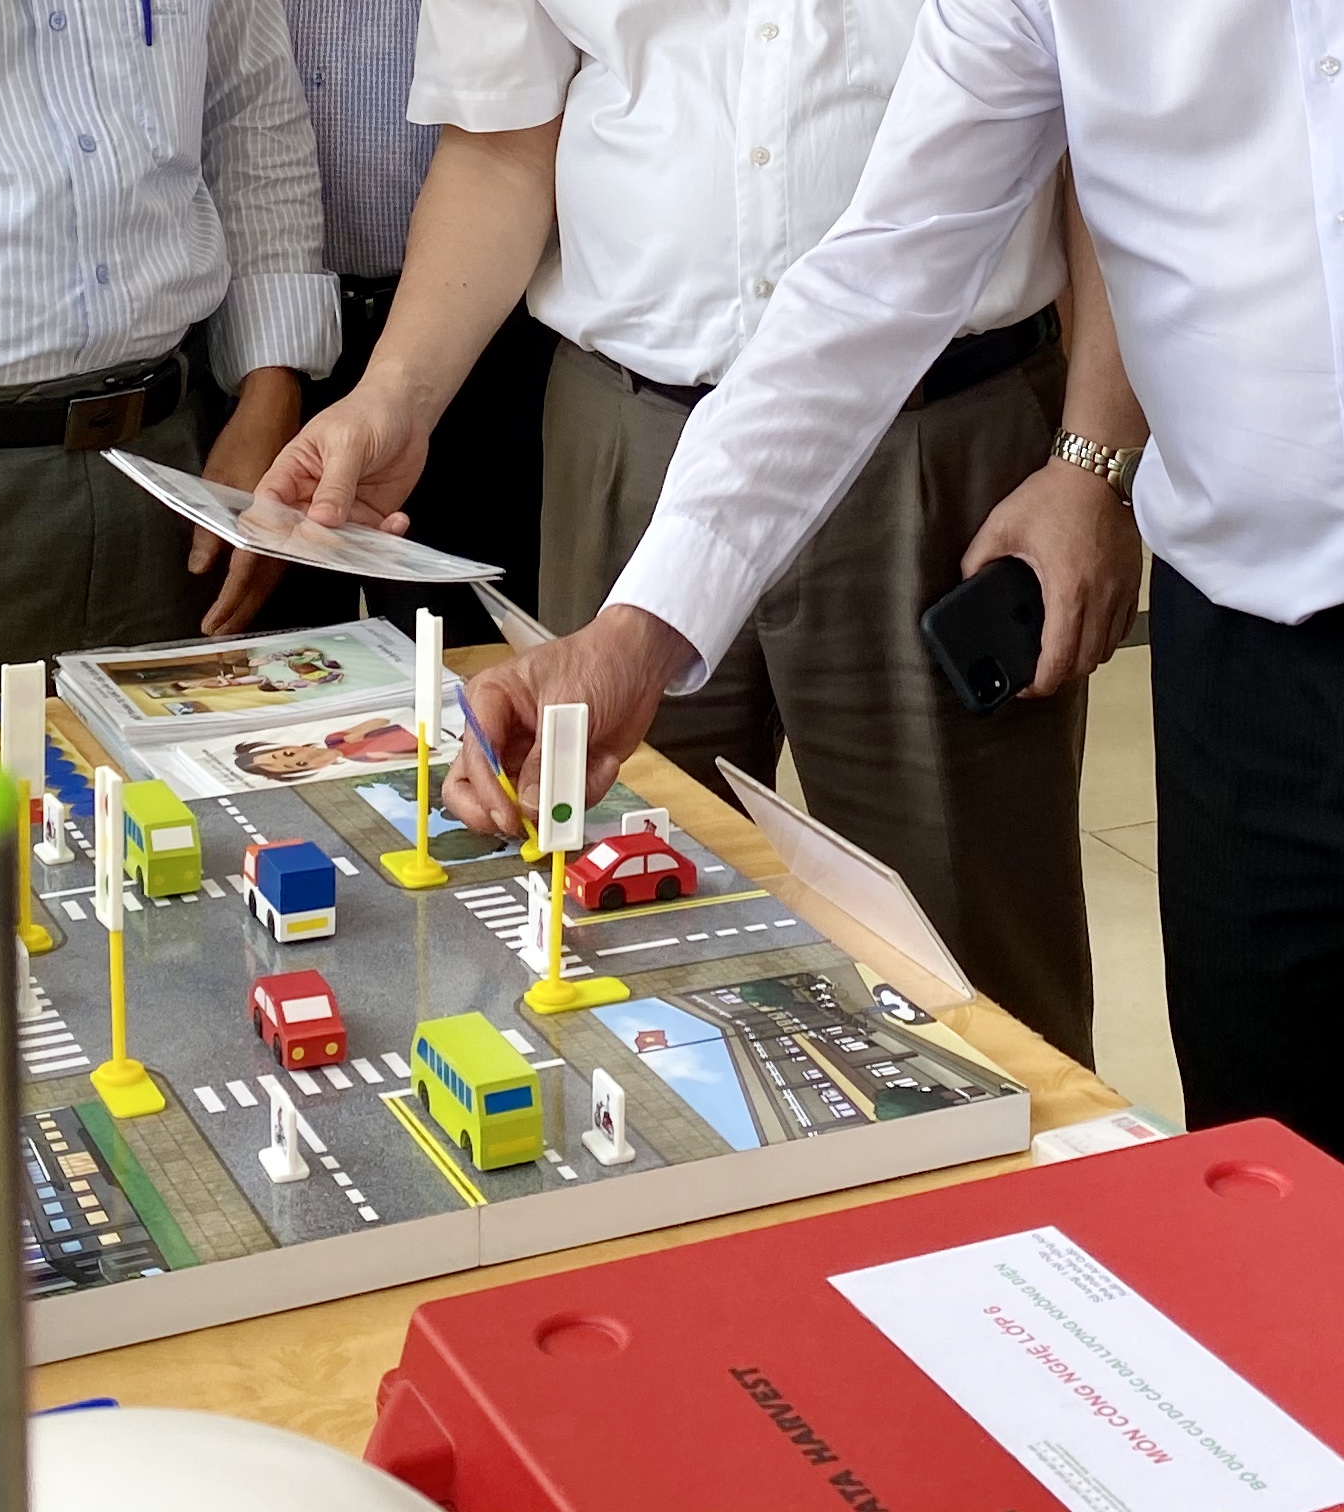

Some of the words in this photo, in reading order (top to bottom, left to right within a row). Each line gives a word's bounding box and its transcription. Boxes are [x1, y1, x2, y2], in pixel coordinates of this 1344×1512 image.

[993, 1262, 1027, 1288] ĐIỆN
[982, 1305, 1002, 1316] 6
[1021, 1285, 1069, 1321] KHÔNG
[993, 1315, 1036, 1345] LỚP
[1062, 1319, 1112, 1361] LƯỢNG
[1026, 1343, 1082, 1385] NGHỆ
[1105, 1356, 1136, 1379] ĐẠI
[1073, 1384, 1130, 1428] CÔNG
[1128, 1376, 1162, 1403] CÁC
[727, 1367, 841, 1466] HARVEST
[1177, 1417, 1204, 1439] CỤ
[1122, 1428, 1174, 1466] MÔN
[1199, 1435, 1245, 1473] DỤNG
[1239, 1469, 1269, 1493] BỘ
